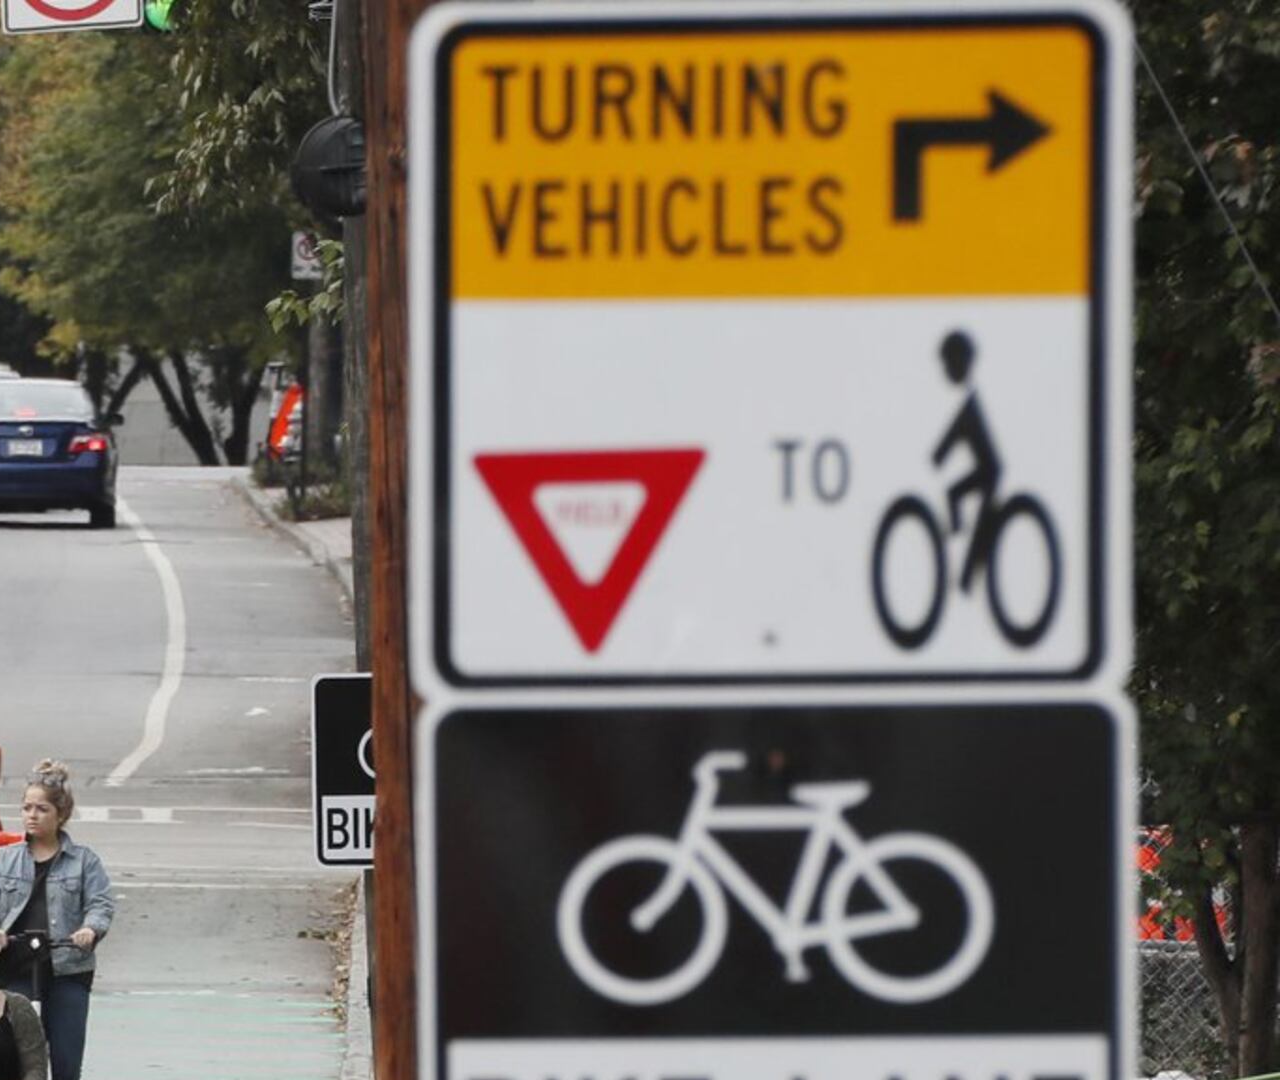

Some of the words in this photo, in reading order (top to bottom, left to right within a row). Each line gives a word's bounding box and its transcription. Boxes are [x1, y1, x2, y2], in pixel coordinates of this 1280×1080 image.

[479, 58, 850, 143] TURNING
[479, 176, 847, 258] VEHICLES
[772, 439, 851, 504] TO
[327, 807, 376, 850] BIK
